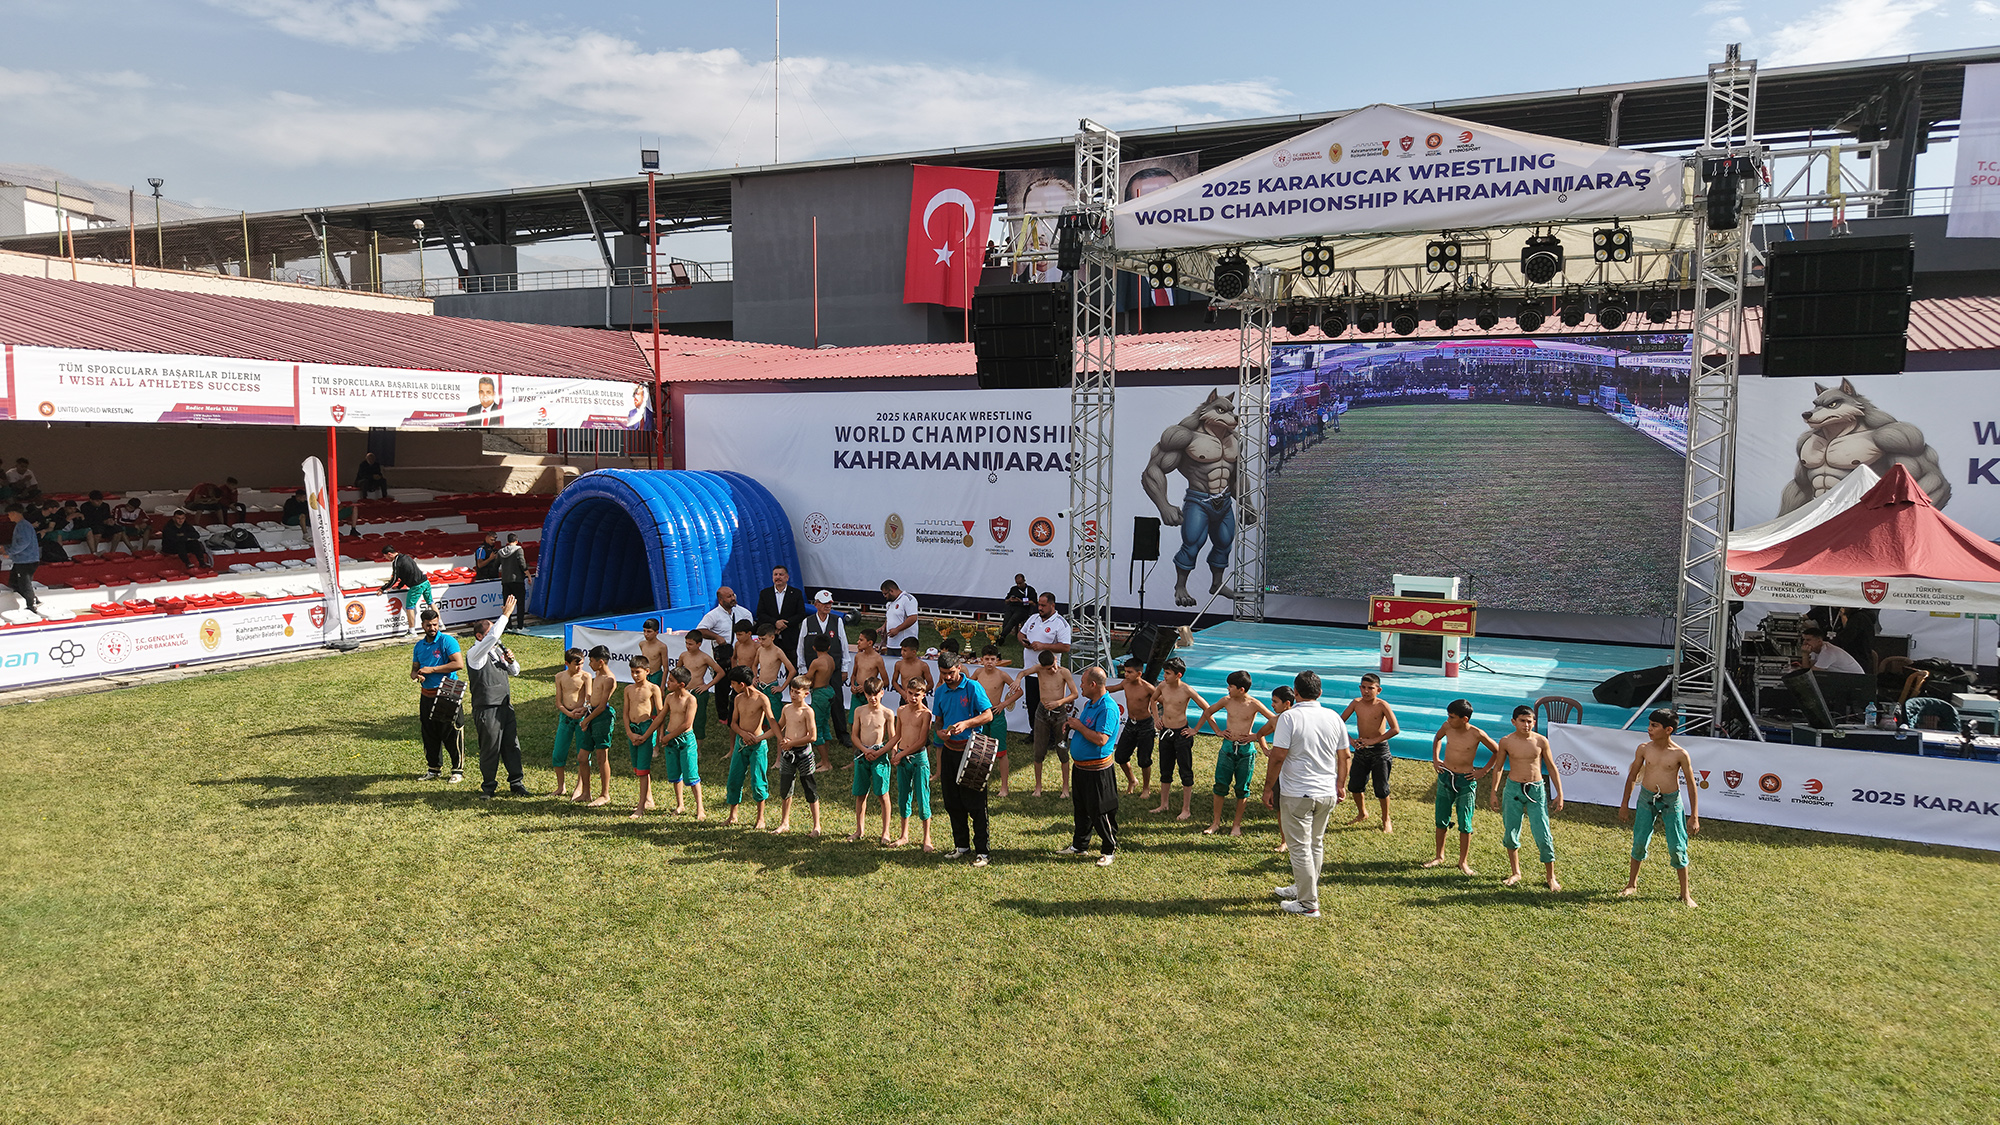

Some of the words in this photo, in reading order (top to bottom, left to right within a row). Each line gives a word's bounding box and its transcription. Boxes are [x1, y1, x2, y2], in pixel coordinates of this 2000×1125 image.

[1202, 180, 1251, 198] 2025
[1258, 166, 1401, 194] KARAKUCAK
[1408, 153, 1556, 180] WRESTLING
[1135, 206, 1215, 226] WORLD
[1220, 191, 1398, 220] CHAMPIONSHIP
[1403, 169, 1652, 203] KAHRAMANMARAŞ
[59, 362, 83, 372] TÜM
[88, 365, 158, 376] SPORCULARA
[163, 368, 218, 379] BAŞARILAR
[222, 370, 261, 380] DİLERİM
[59, 375, 64, 384] I
[69, 376, 104, 386] WISH
[110, 378, 134, 387] ALL
[139, 379, 204, 390] ATHLETES
[208, 382, 260, 392] SUCCESS
[312, 376, 329, 384] TÜM
[333, 378, 385, 387] SPORCULARA
[320, 387, 345, 396] WISH
[371, 390, 418, 399] ATHLETES
[422, 392, 460, 400] SUCCESS
[876, 412, 900, 422] 2025
[903, 412, 966, 422] KARAKUCAK
[969, 411, 1032, 421] WRESTLING
[835, 426, 906, 443] WORLD
[0, 652, 39, 668] an
[1791, 798, 1834, 807] ETHNOSPORT
[1852, 788, 1906, 806] 2025
[1913, 794, 2000, 817] KARAK
